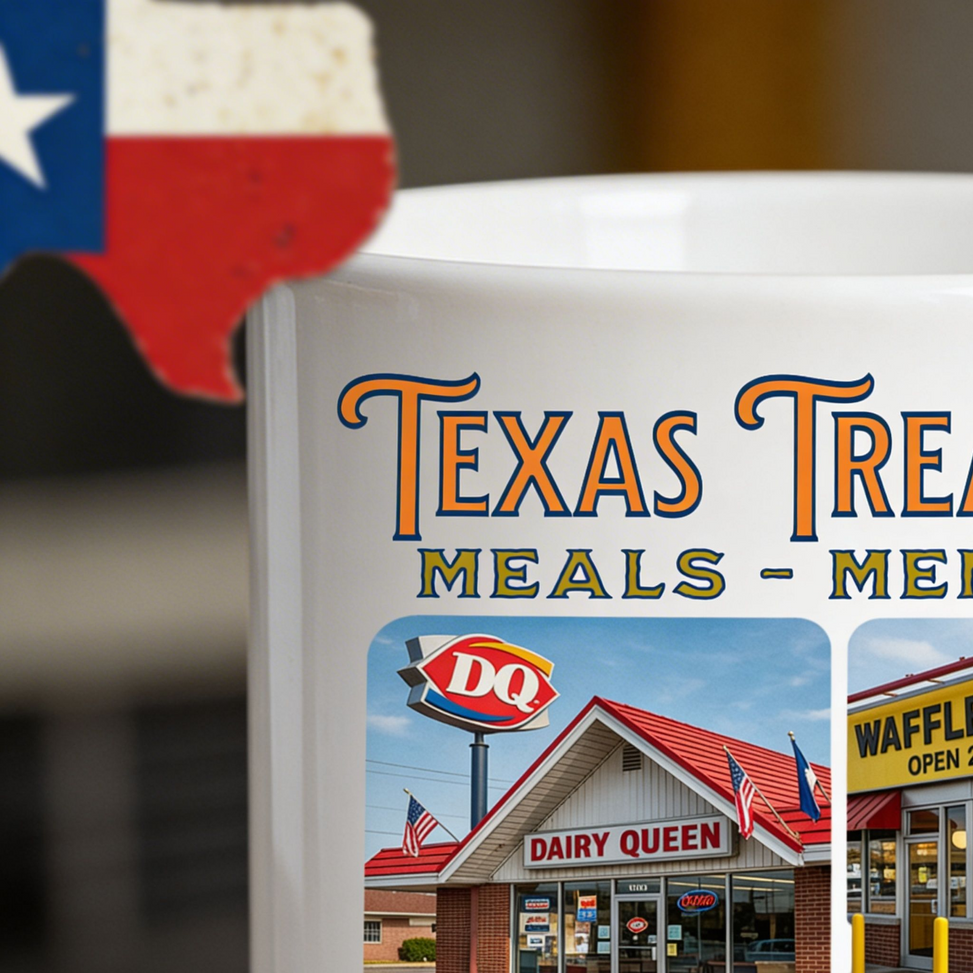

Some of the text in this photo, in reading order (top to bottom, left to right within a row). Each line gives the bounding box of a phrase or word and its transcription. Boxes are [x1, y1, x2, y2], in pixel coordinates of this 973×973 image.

[338, 373, 703, 542] TEXAS
[417, 547, 726, 599] MEALS
[446, 651, 539, 713] DQ
[908, 752, 960, 776] OPEN
[530, 821, 721, 863] DAIRY QUEEN
